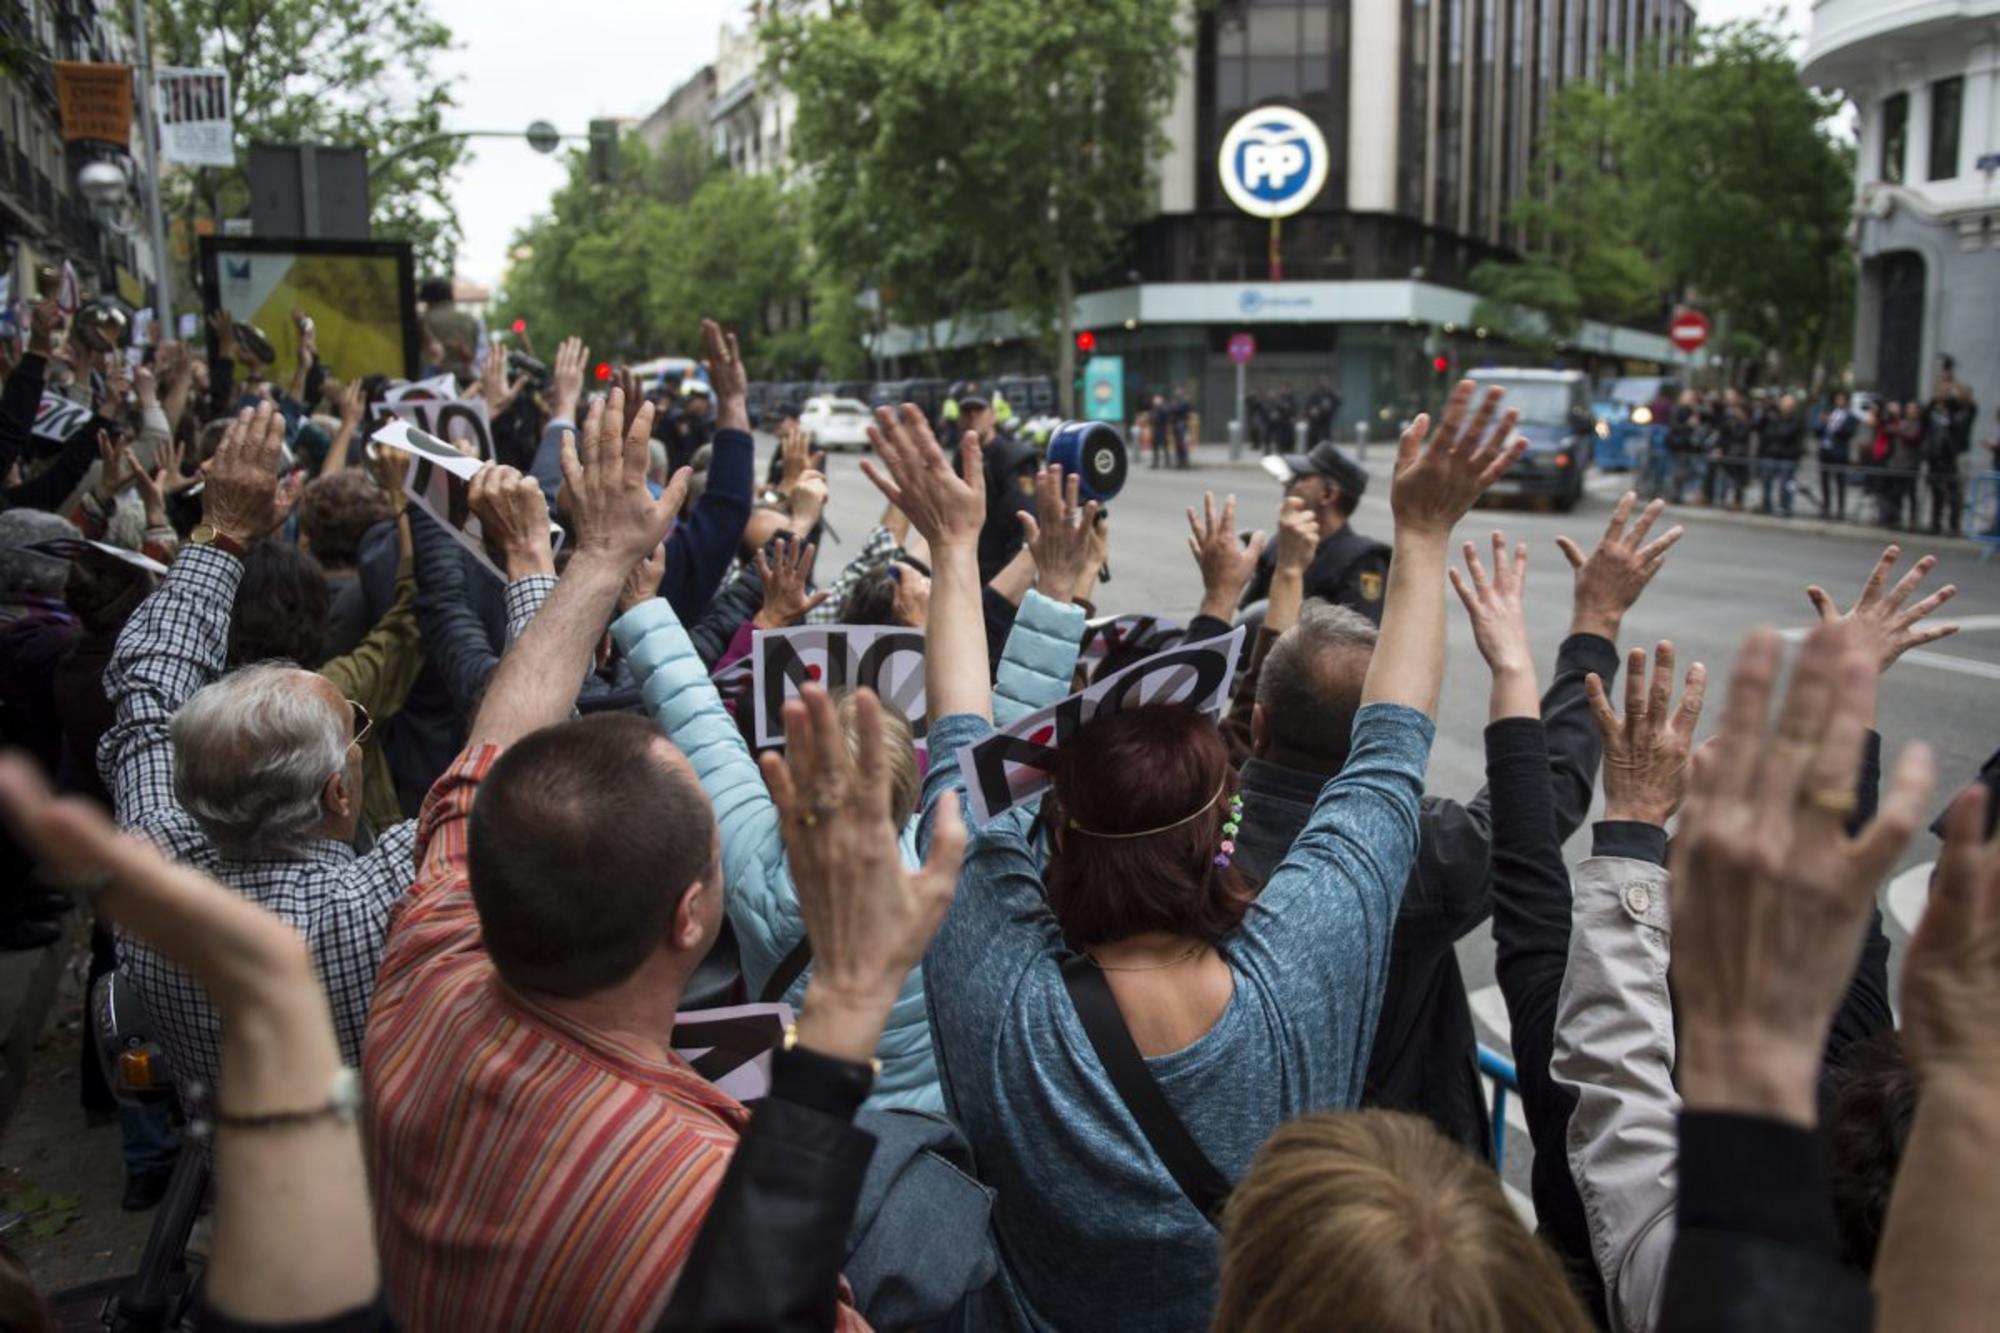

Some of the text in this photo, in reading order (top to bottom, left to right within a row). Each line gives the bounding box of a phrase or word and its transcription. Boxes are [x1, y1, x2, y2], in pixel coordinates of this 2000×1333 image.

[1243, 143, 1305, 190] PP
[763, 632, 927, 739] NO
[972, 649, 1228, 818] NO
